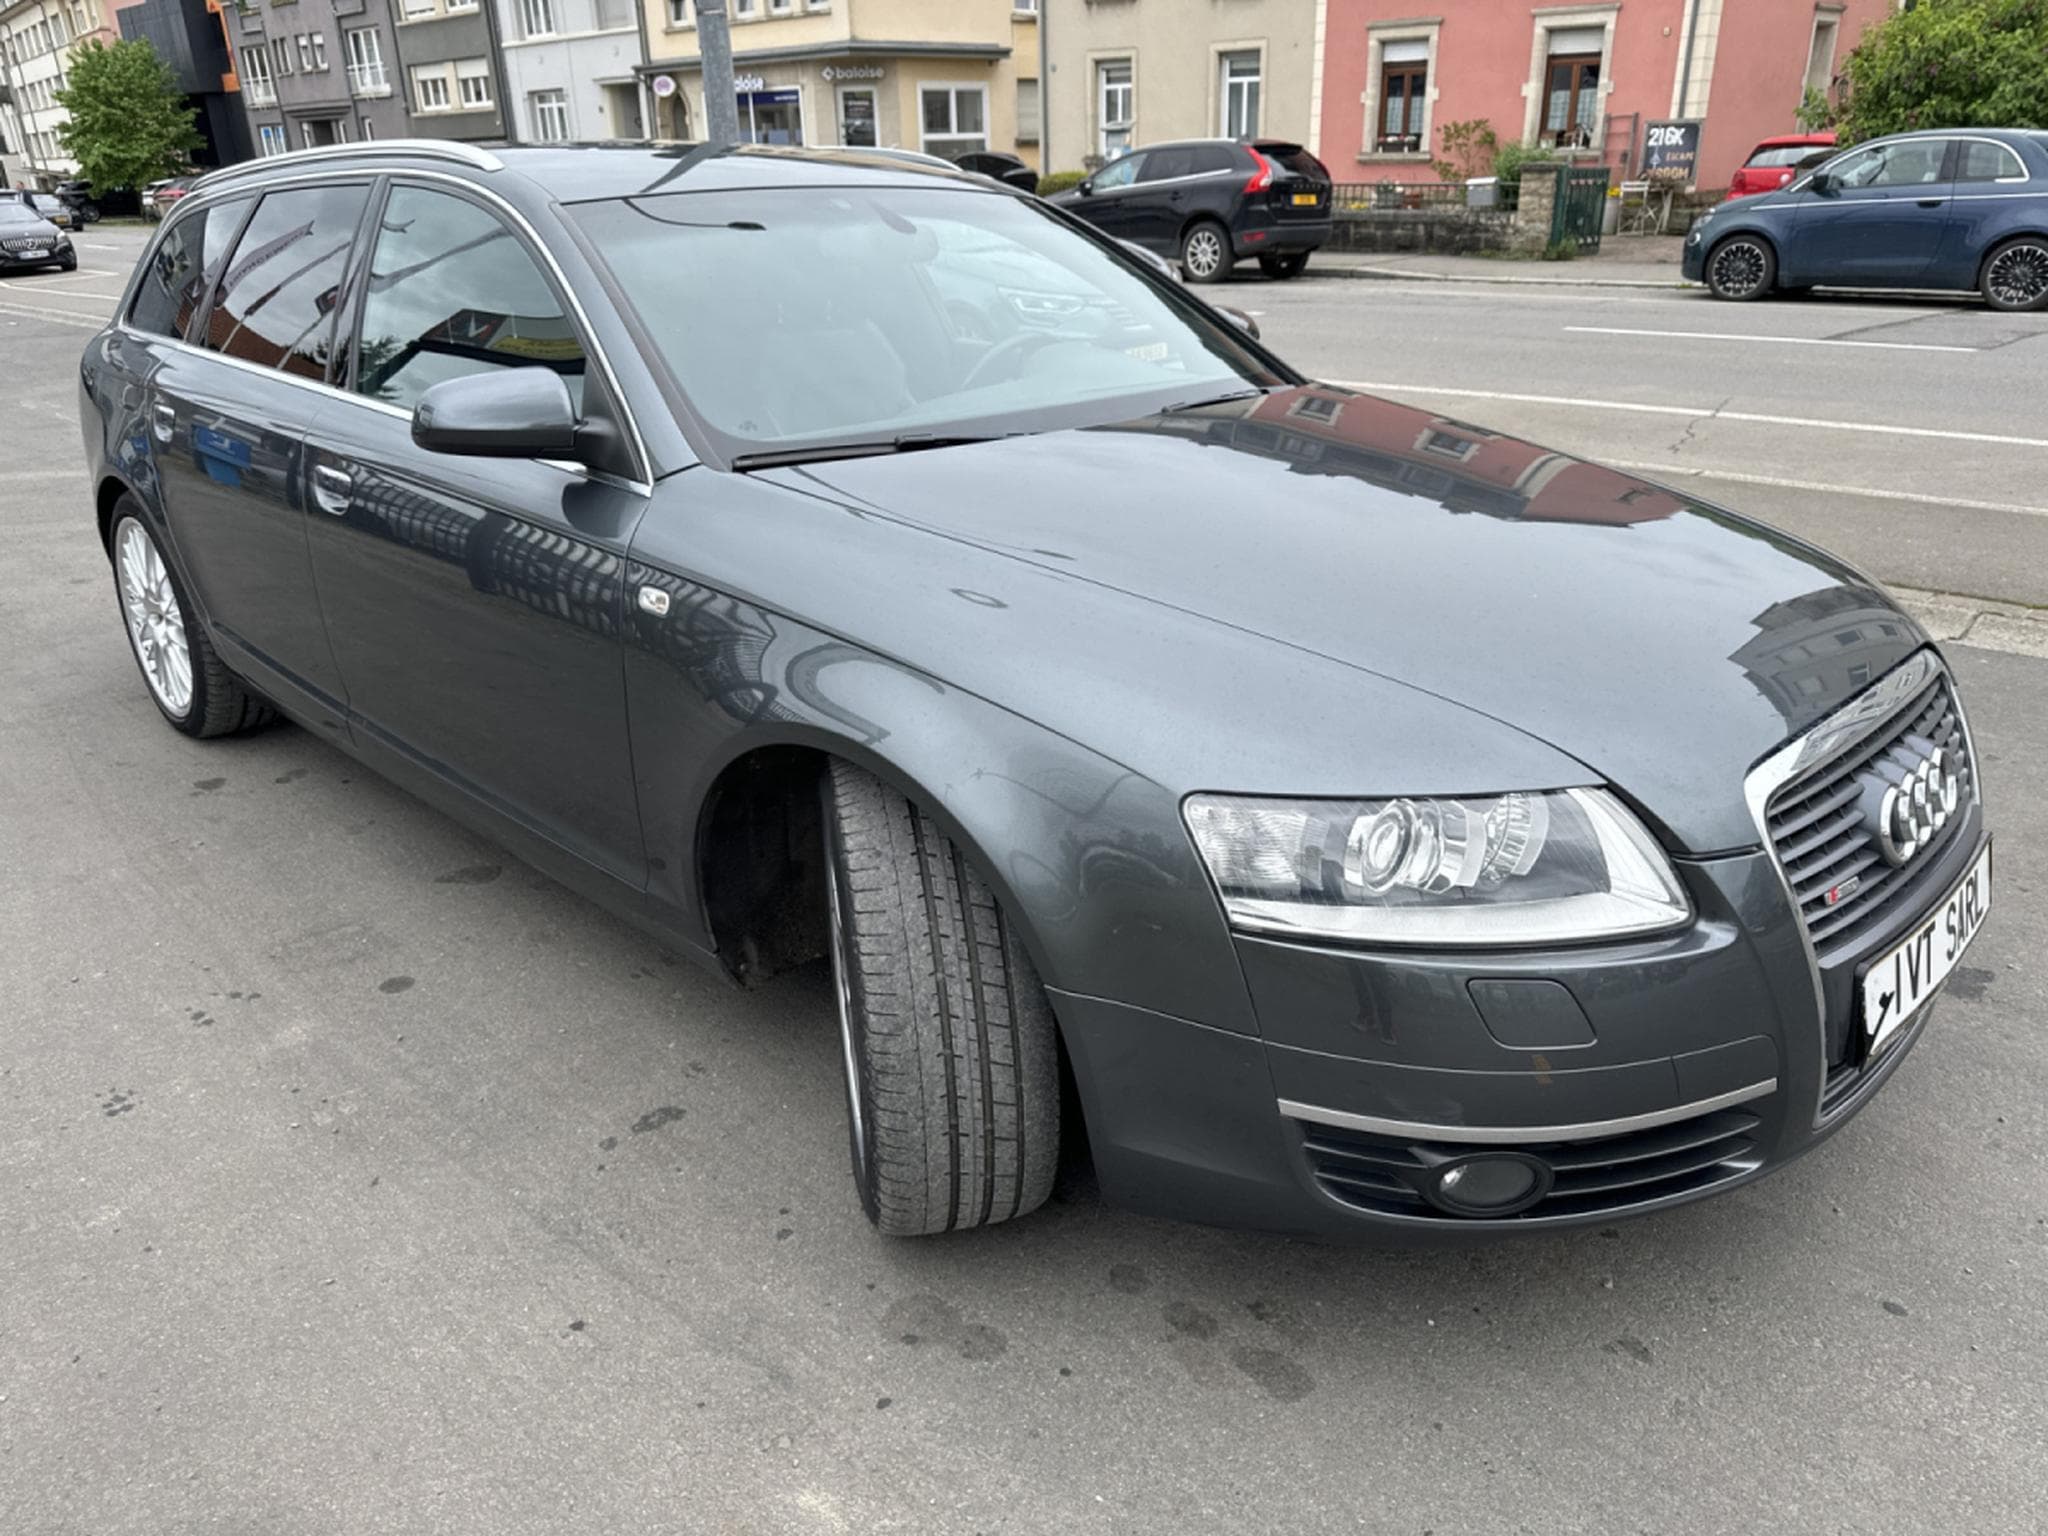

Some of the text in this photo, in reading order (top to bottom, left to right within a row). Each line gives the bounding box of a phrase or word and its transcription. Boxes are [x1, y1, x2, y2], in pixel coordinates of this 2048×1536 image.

[835, 66, 884, 79] baloise
[734, 74, 763, 91] aloise
[1895, 868, 1984, 1015] IVT SARL
